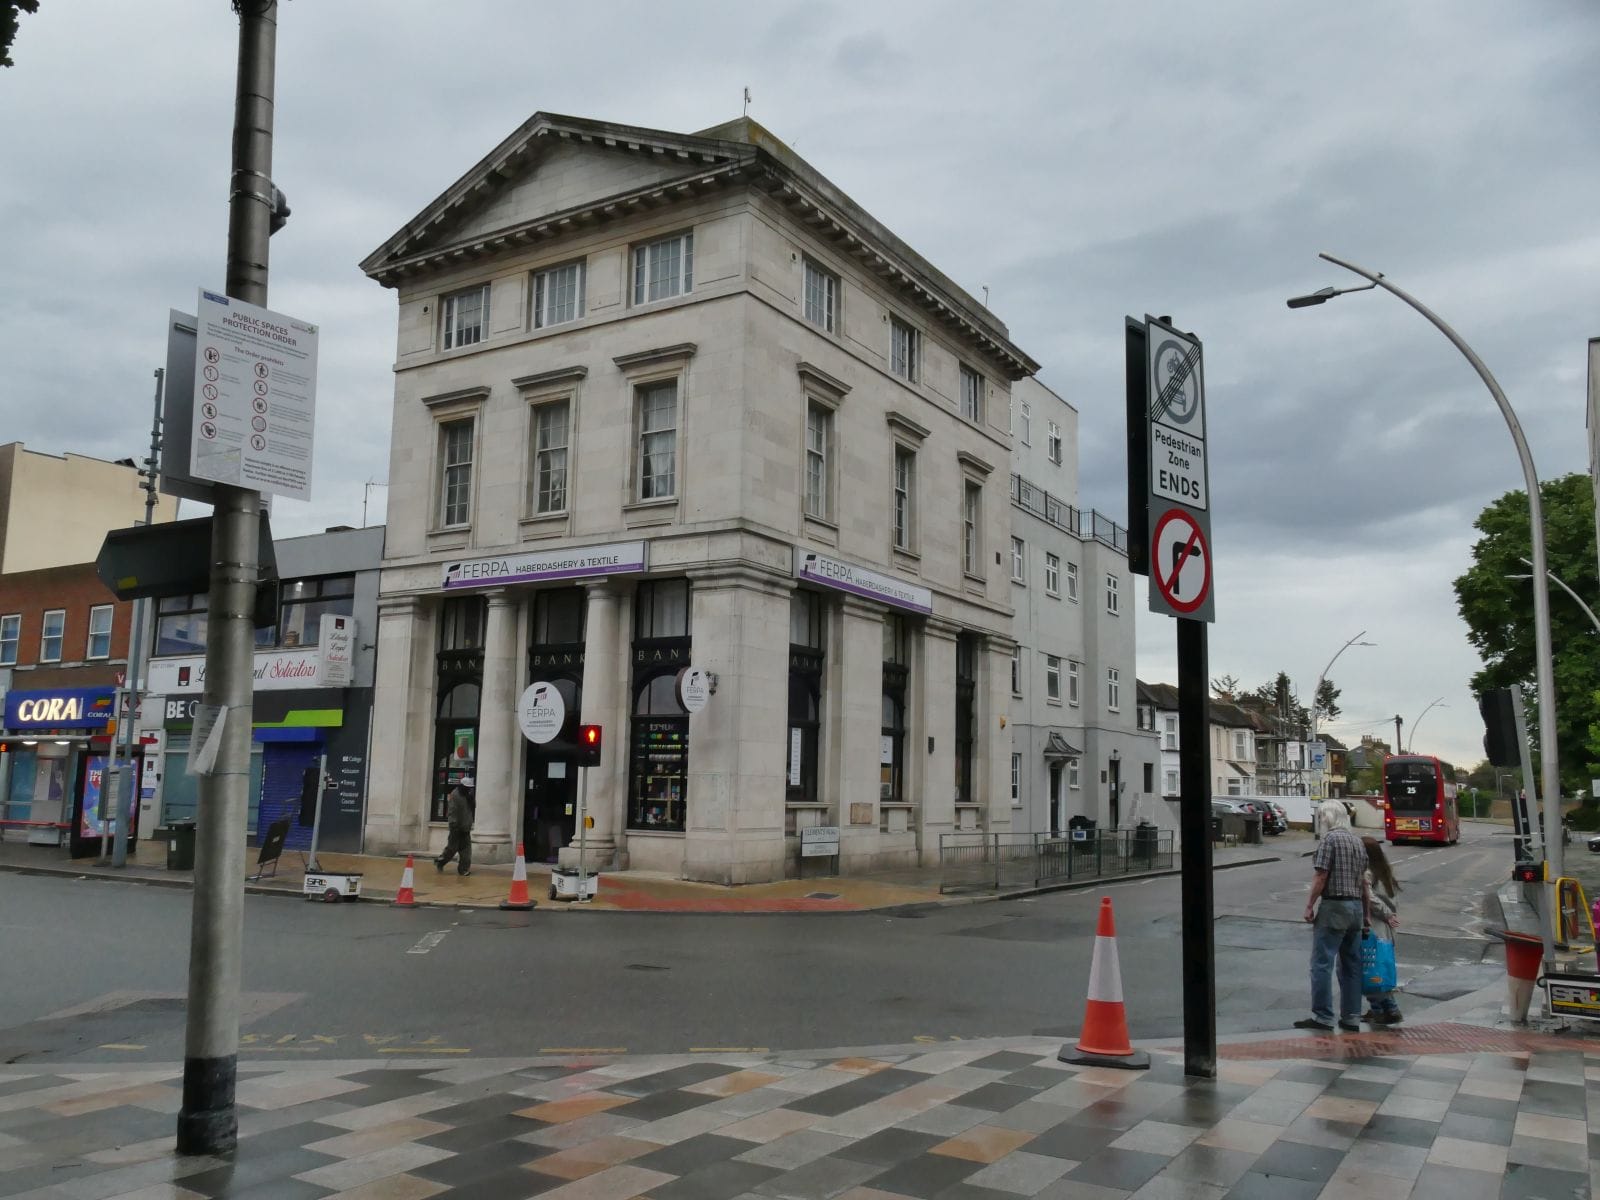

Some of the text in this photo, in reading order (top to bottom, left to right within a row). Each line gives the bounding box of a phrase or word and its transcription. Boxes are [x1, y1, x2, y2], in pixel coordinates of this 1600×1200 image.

[222, 317, 271, 338] PROTECTION
[272, 332, 297, 347] ORDER
[232, 311, 260, 326] PUBLIC
[261, 319, 289, 336] SPACES
[1155, 428, 1201, 458] Pedestrian
[1168, 450, 1190, 470] Zone
[1159, 469, 1200, 500] ENDS
[463, 560, 510, 579] FERPA
[515, 559, 579, 573] HABERDASHERY
[580, 559, 586, 568] &
[587, 555, 619, 567] TEXTILE
[820, 559, 853, 582] FERPA
[269, 657, 317, 679] Solicitors
[442, 659, 477, 670] BAN
[166, 700, 185, 719] BE
[526, 708, 555, 718] FERPA
[1406, 786, 1417, 794] 25
